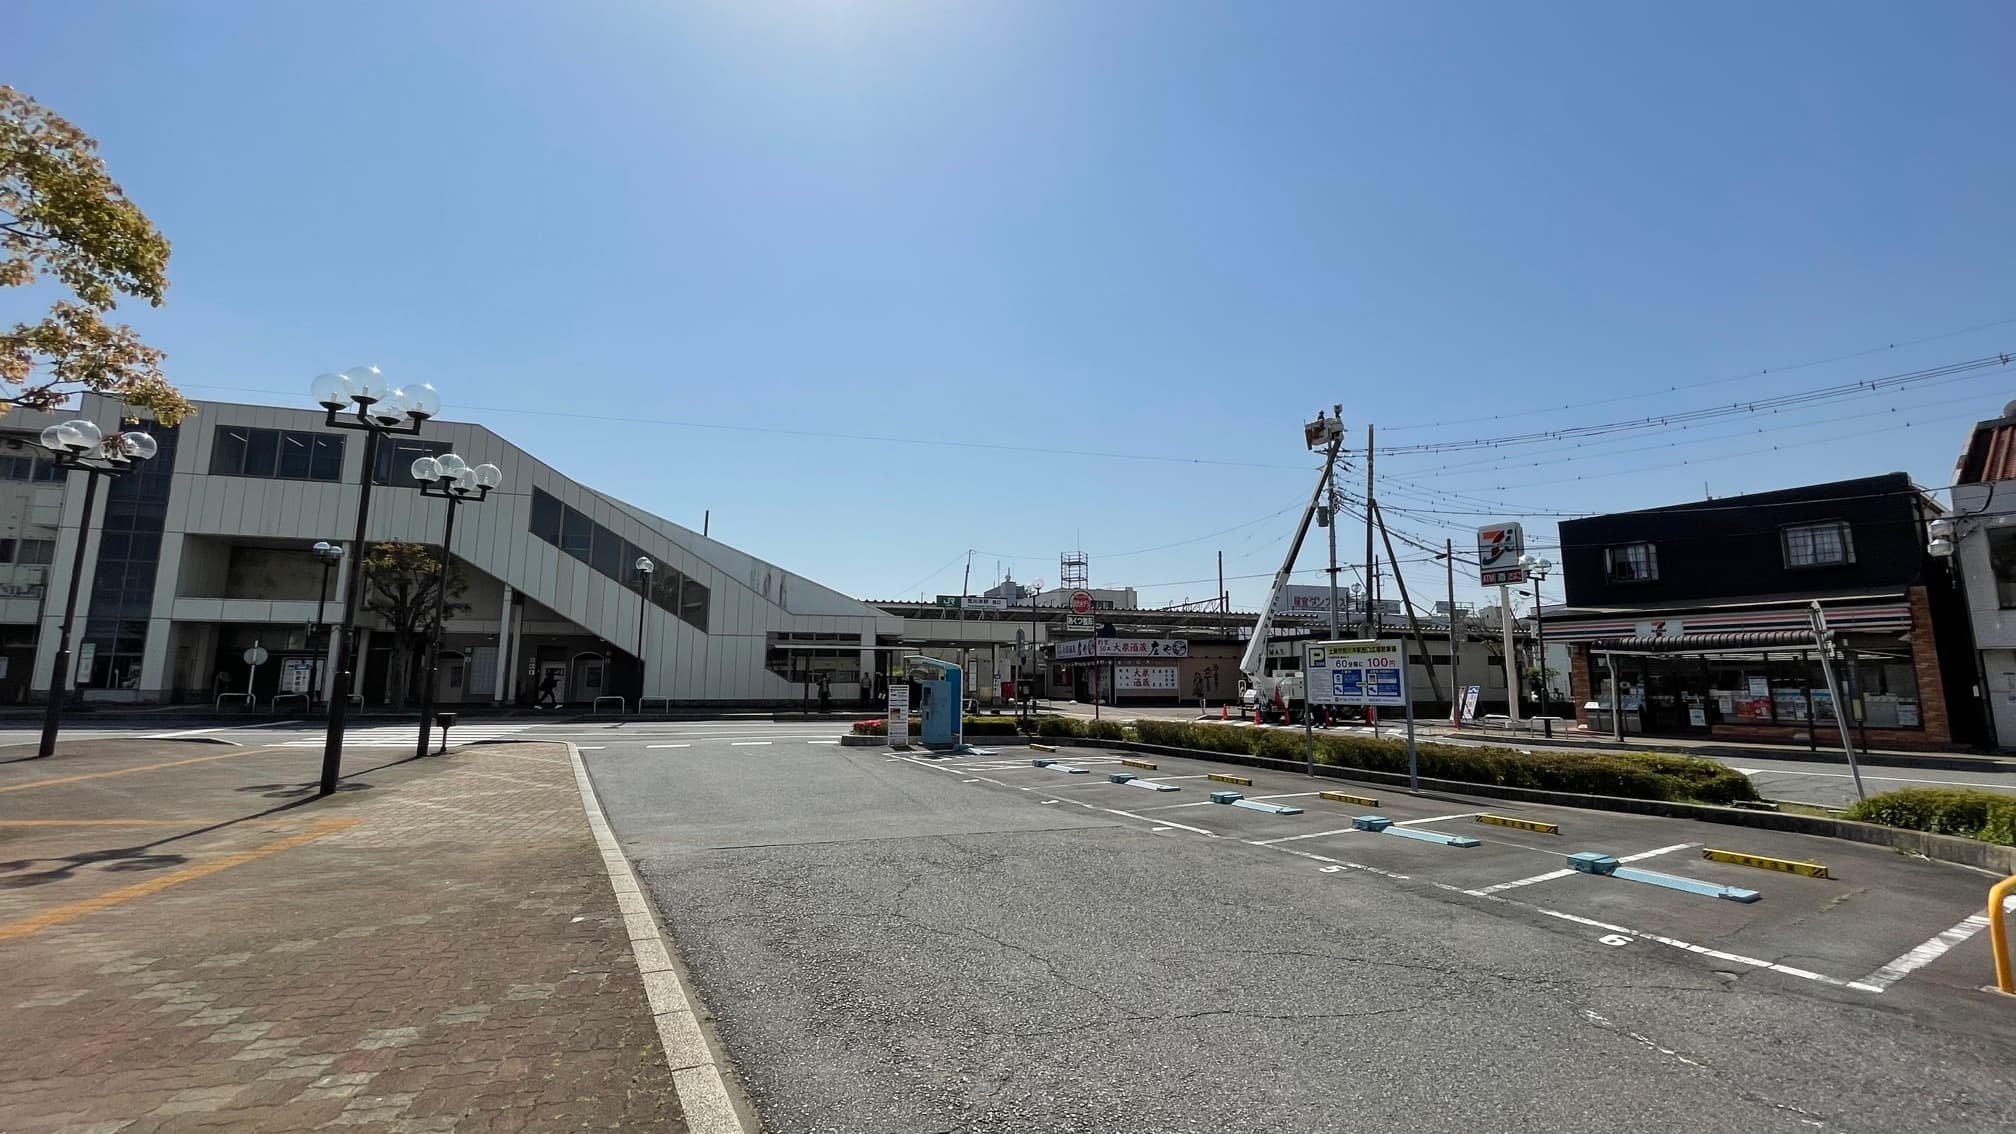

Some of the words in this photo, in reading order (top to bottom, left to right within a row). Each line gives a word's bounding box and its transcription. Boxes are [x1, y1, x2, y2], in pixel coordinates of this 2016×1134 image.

[943, 597, 956, 605] JR
[1367, 657, 1396, 668] 100円
[1598, 934, 1634, 946] 6
